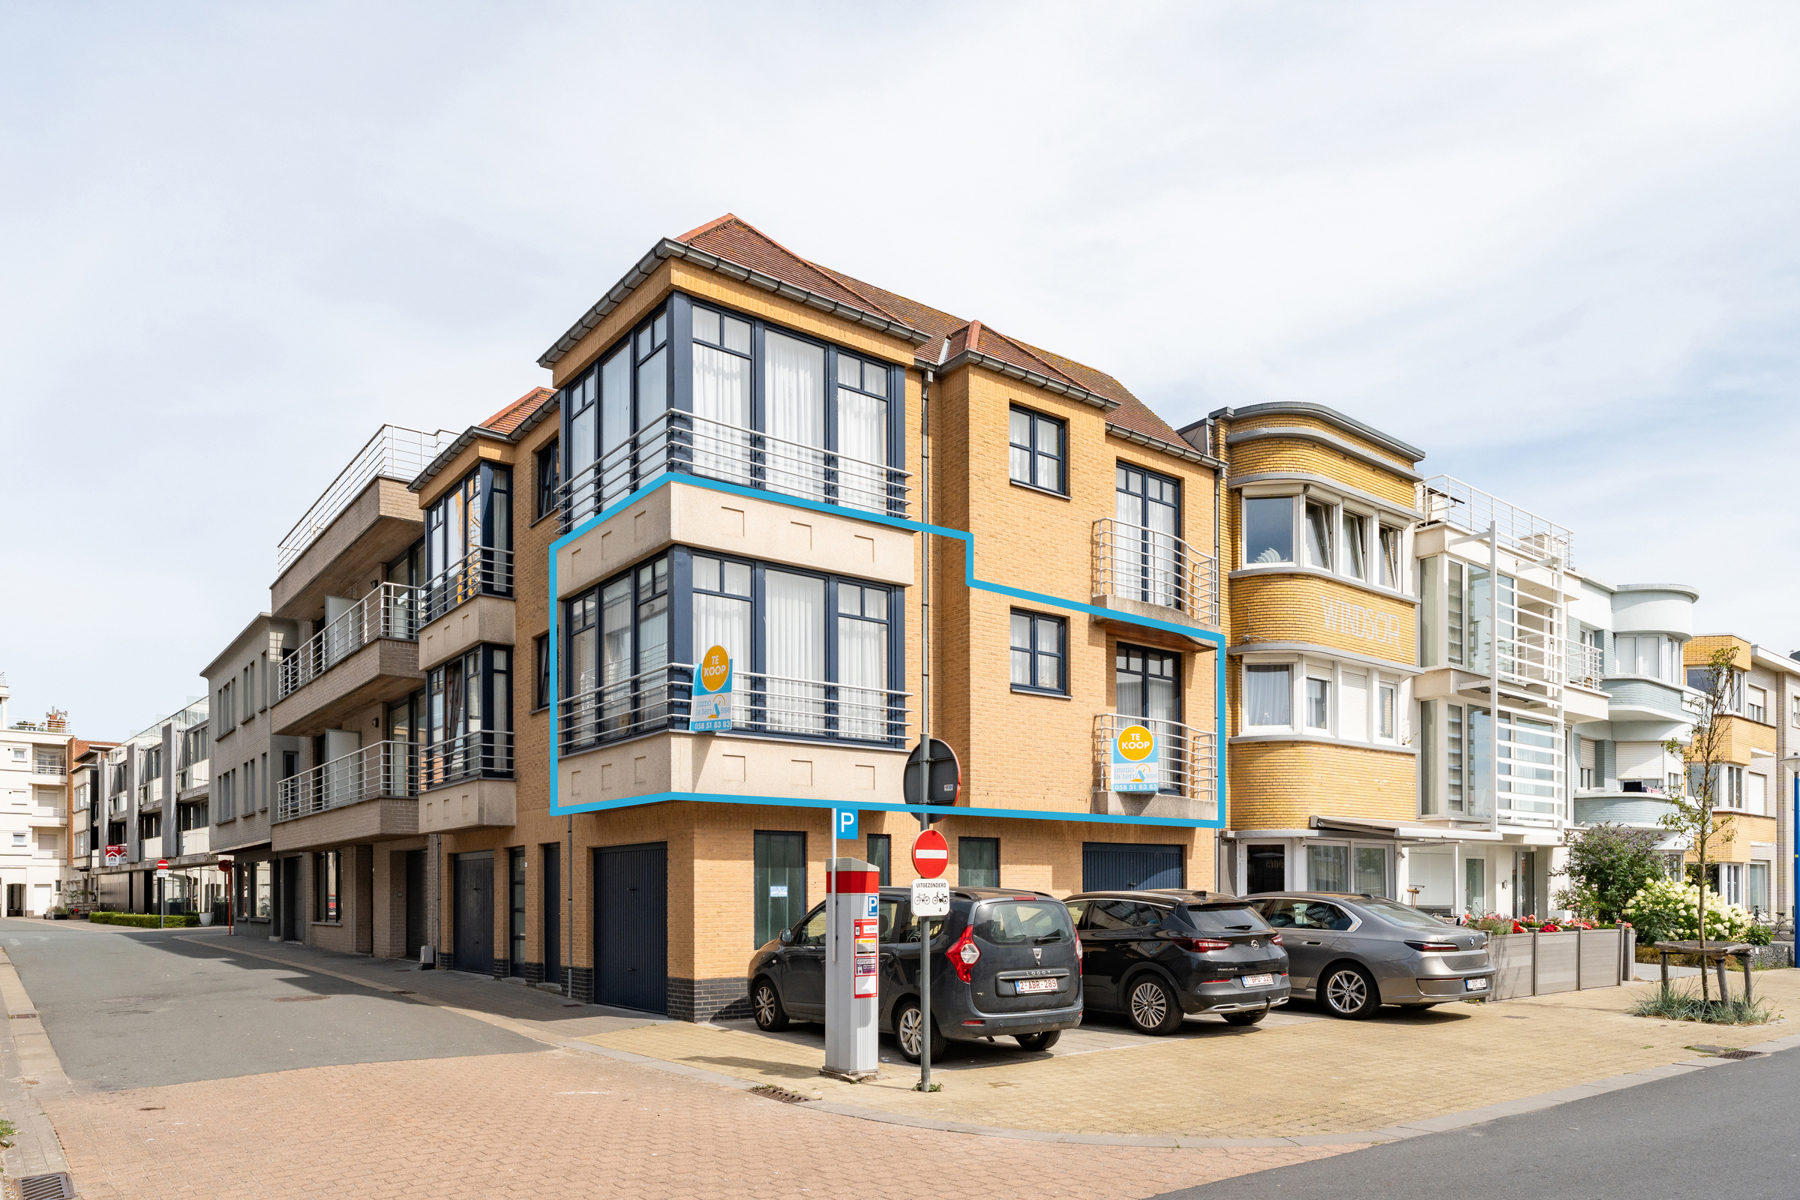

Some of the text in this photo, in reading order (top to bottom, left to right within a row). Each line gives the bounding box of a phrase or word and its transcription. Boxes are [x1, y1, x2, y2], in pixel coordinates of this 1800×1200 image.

[1321, 596, 1404, 656] WINDSOR
[711, 655, 719, 665] TE
[704, 665, 726, 677] KOOP
[694, 722, 704, 730] 058
[1122, 742, 1150, 750] KOOP
[840, 812, 855, 833] P
[868, 897, 877, 912] P
[1020, 979, 1058, 990] 2-ABR-289
